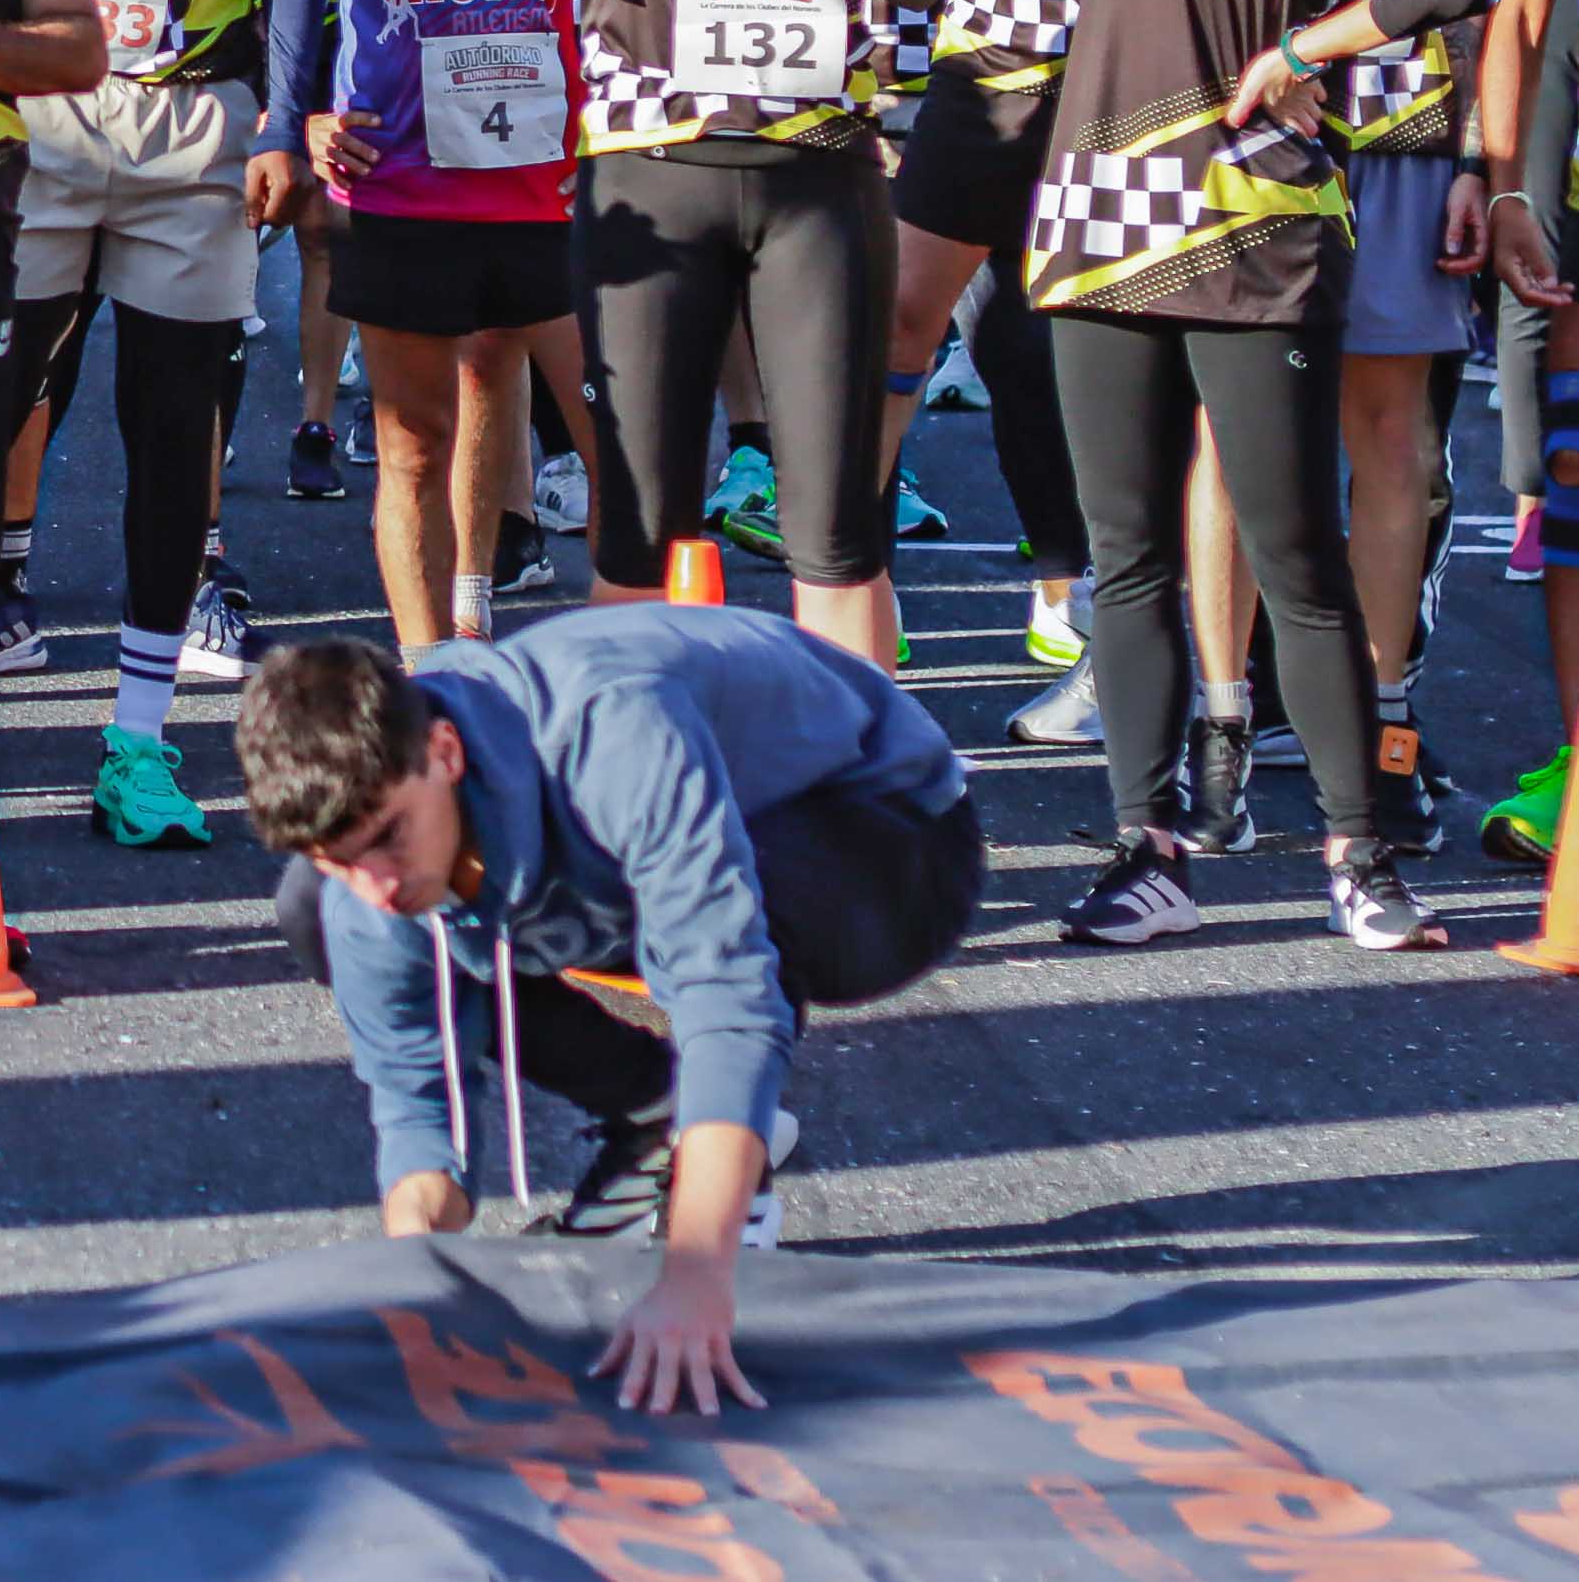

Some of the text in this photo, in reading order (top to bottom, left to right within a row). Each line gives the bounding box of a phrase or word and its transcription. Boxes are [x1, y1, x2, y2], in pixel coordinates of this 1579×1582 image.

[444, 42, 543, 71] AUTÓDROMO
[704, 21, 817, 69] 132
[462, 66, 530, 83] RUNNING RACE
[481, 101, 514, 142] 4
